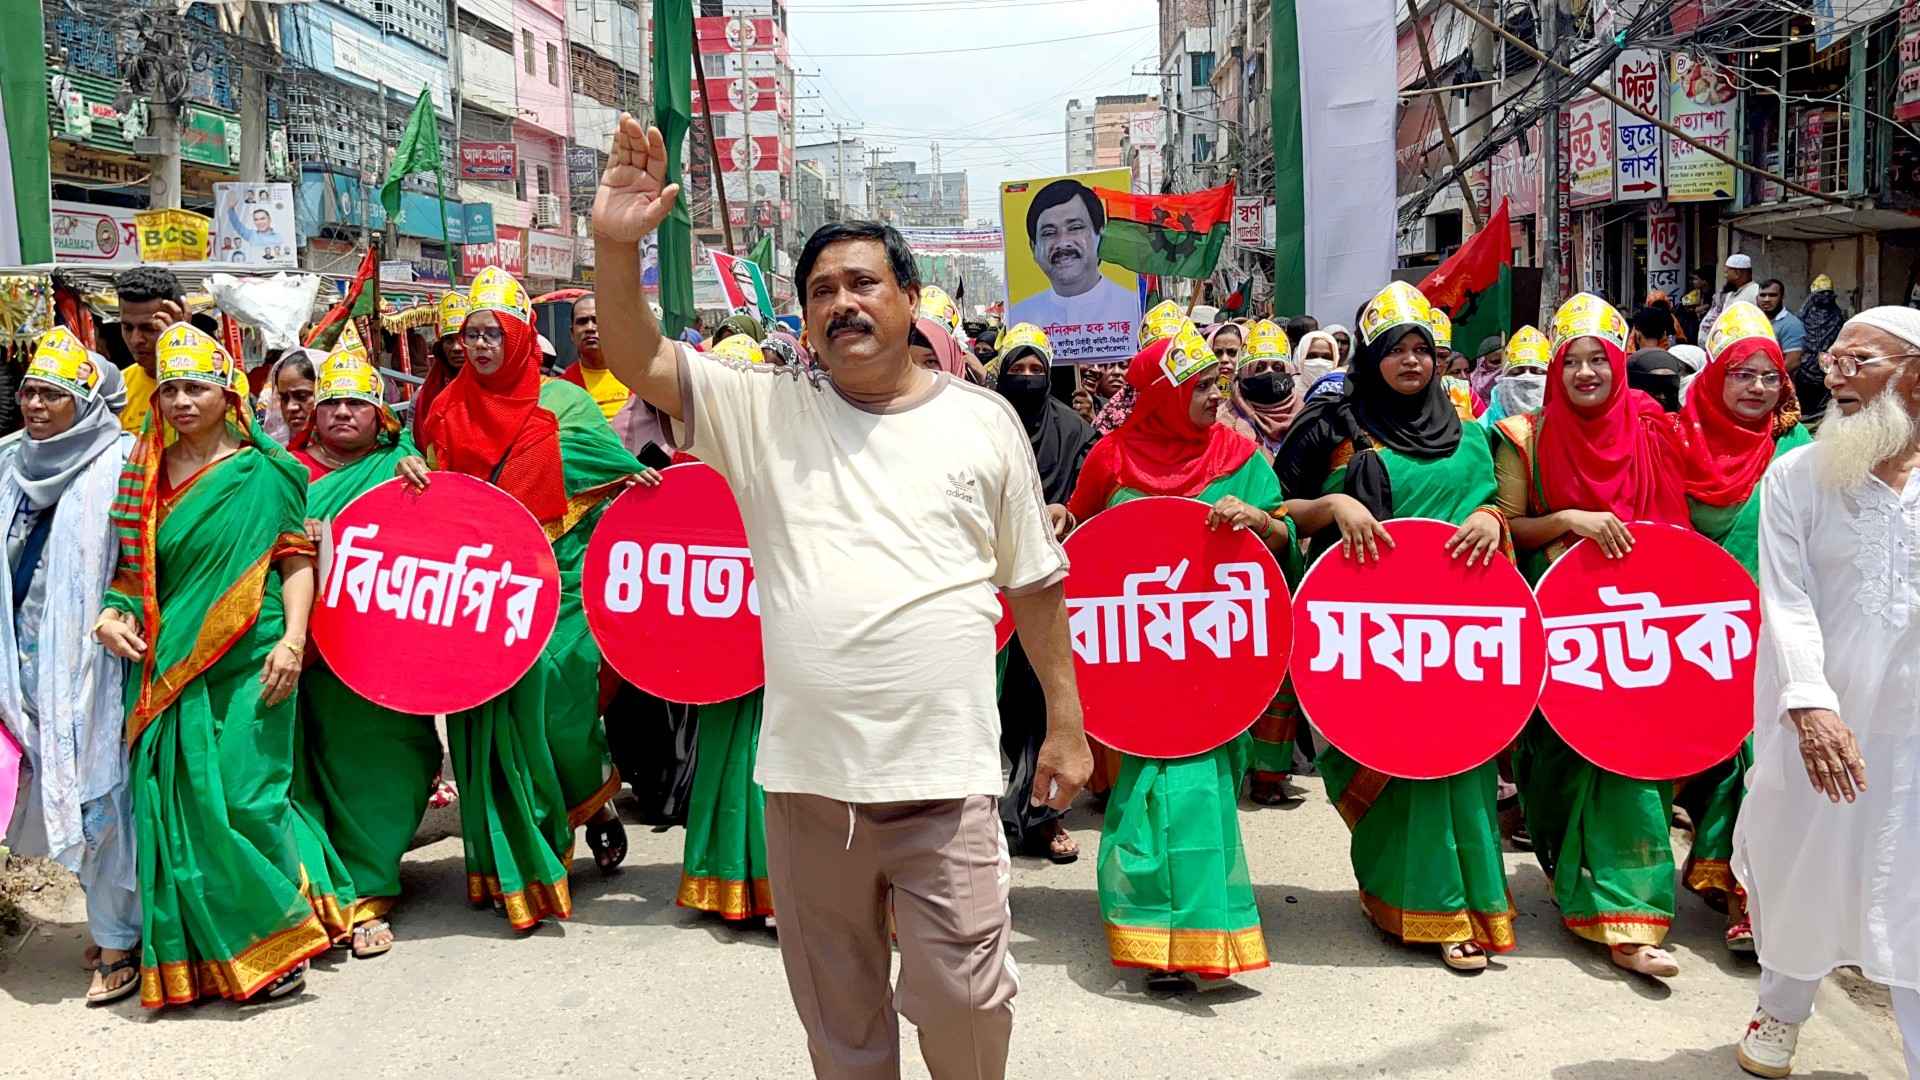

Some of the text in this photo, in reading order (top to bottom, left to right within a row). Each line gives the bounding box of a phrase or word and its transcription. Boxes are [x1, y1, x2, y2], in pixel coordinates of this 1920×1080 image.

[1618, 60, 1658, 116] পিন্টু
[1672, 111, 1727, 130] প্রত্যাশা
[1619, 148, 1658, 179] লার্স
[1237, 201, 1261, 223] স্বর্ণ
[54, 238, 95, 251] PHARMACY
[144, 226, 198, 247] BCS
[1043, 320, 1131, 337] মনিরুল হক সাক্কু
[326, 523, 544, 647] বিএনপি'র
[1064, 557, 1271, 665] বার্ষিকী
[1306, 600, 1527, 686] সফল
[1544, 585, 1754, 691] হউক
